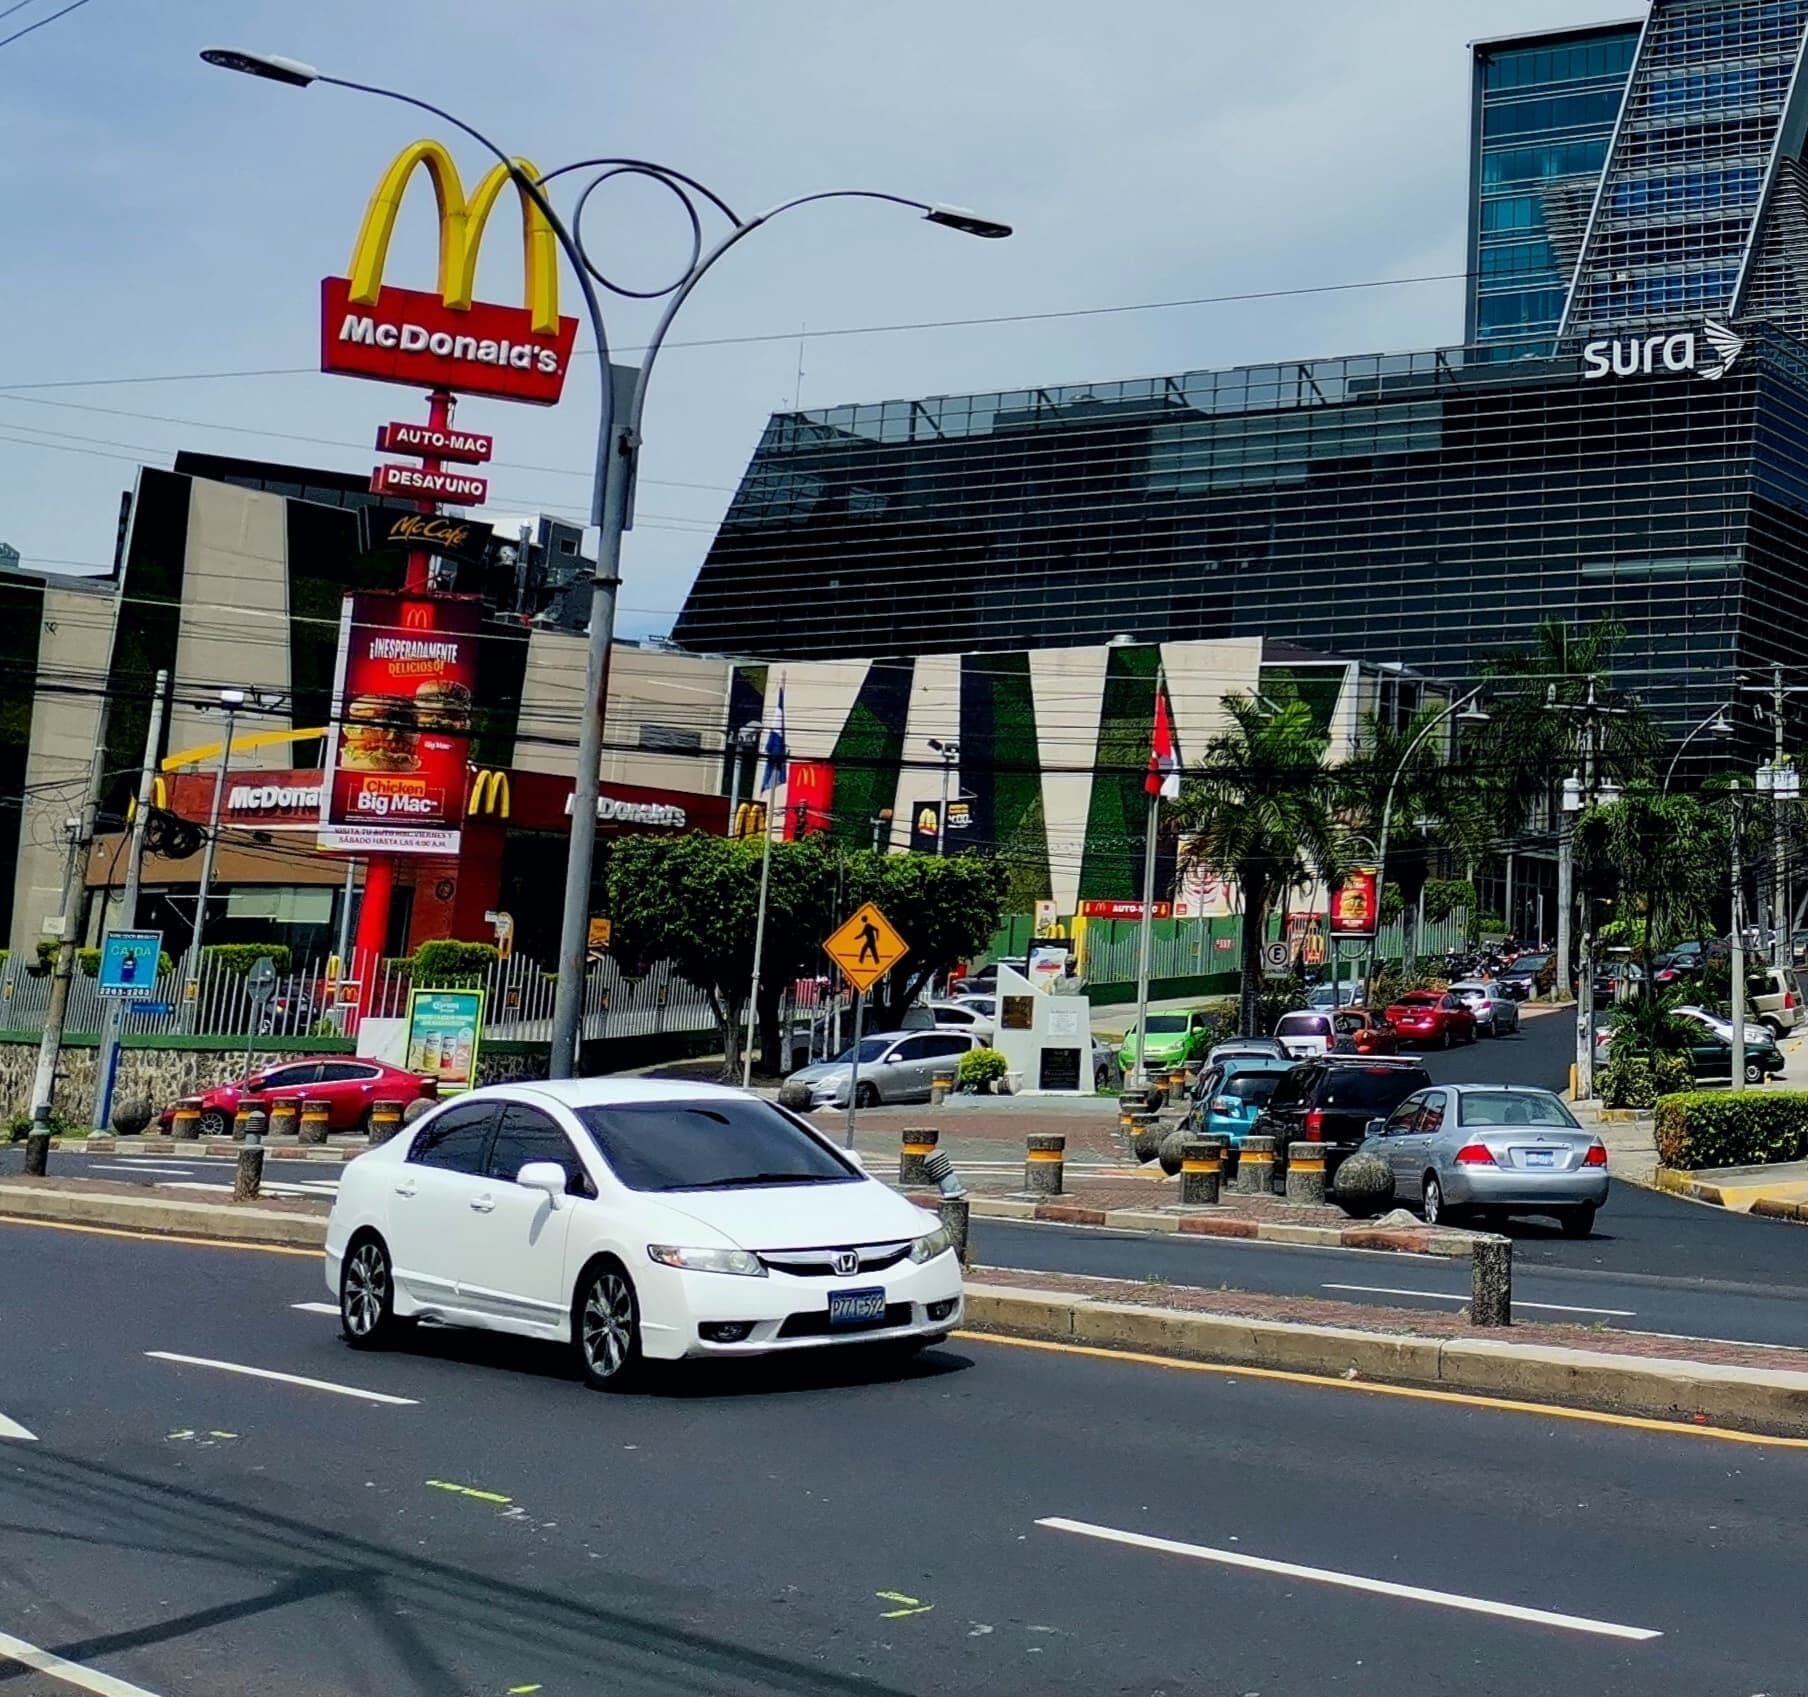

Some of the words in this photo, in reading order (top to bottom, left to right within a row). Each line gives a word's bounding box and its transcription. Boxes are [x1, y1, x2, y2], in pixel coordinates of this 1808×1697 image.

[338, 314, 558, 373] McDonald's
[1583, 333, 1695, 379] sura
[397, 428, 488, 453] AUTO-MAC
[387, 469, 484, 496] DESAYUNO
[366, 780, 425, 795] Chicken
[357, 792, 389, 816] Big
[373, 837, 399, 846] HASTA
[399, 839, 414, 847] LAS
